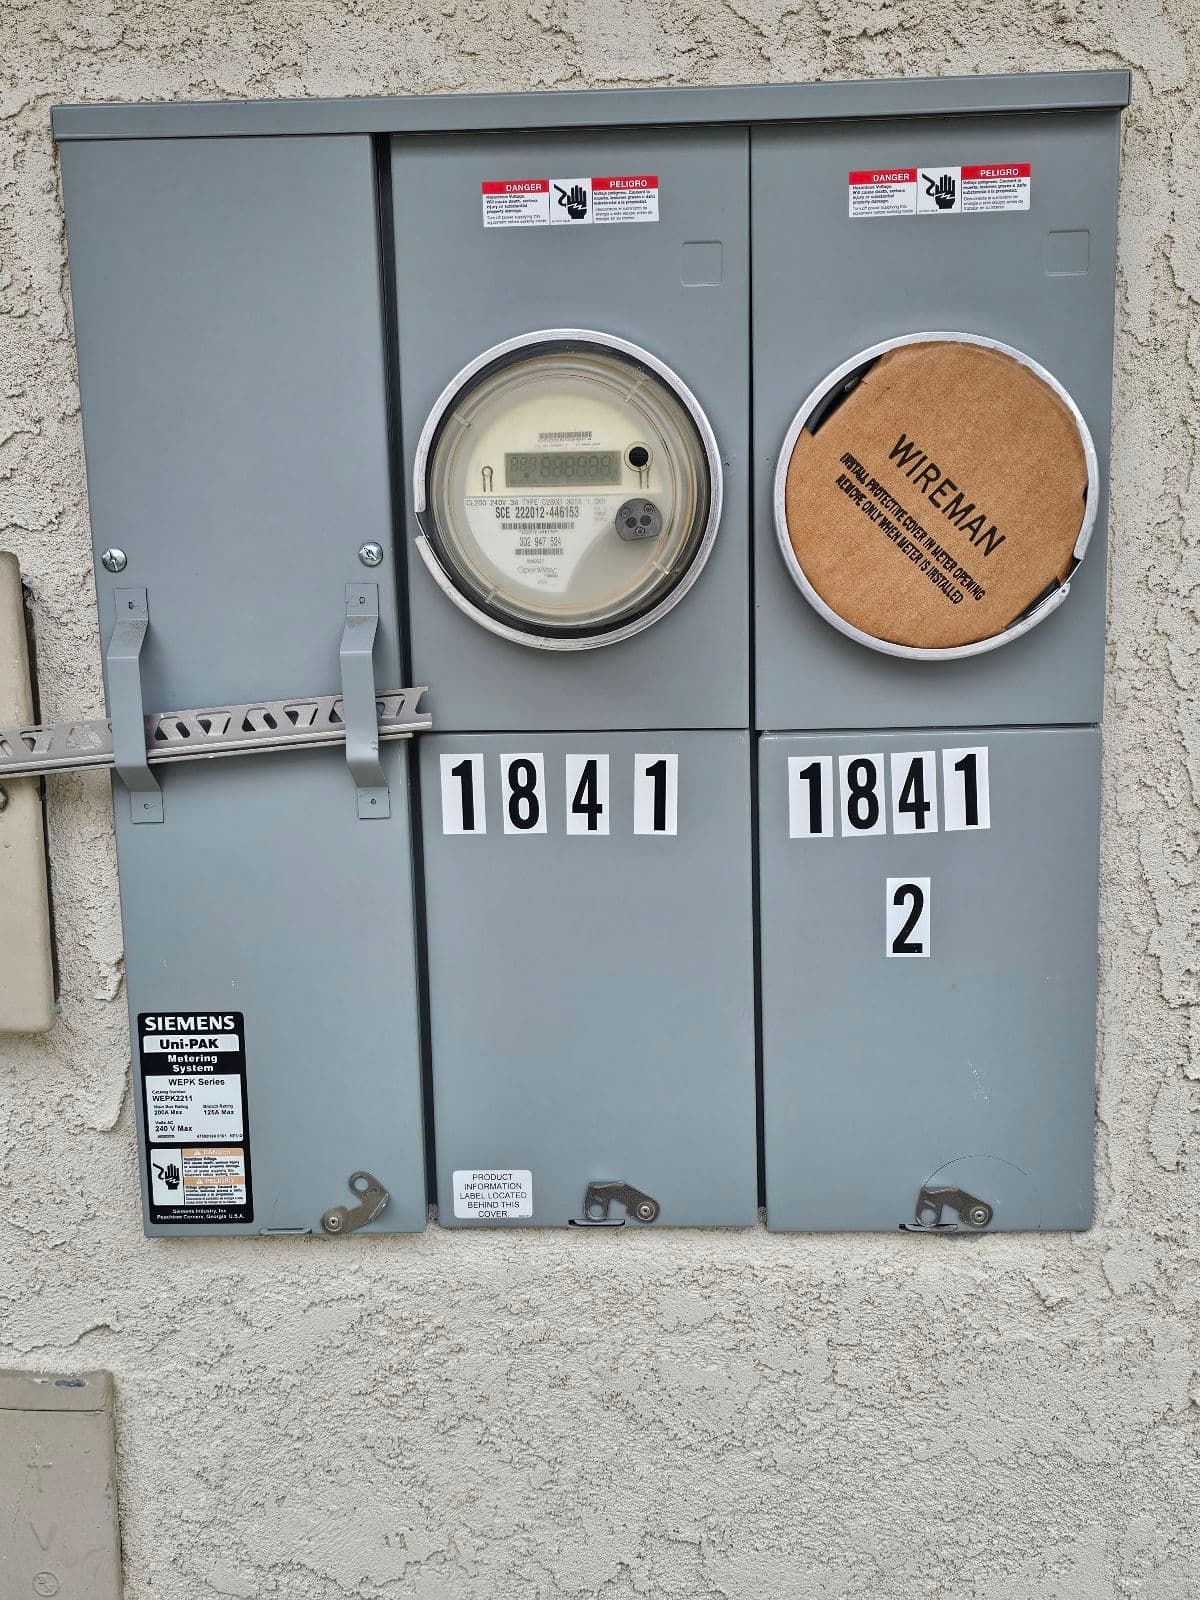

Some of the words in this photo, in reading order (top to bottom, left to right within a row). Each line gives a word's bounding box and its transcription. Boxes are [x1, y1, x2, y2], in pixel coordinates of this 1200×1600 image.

[980, 168, 1019, 176] PELIGRO
[873, 174, 910, 182] DANGER
[505, 184, 542, 192] DANGER
[609, 180, 648, 188] PELIGRO
[888, 434, 1006, 556] WIREMAN
[495, 507, 510, 518] SCE
[515, 506, 579, 518] 222012-446153
[840, 452, 869, 484] INSTALL
[865, 478, 908, 522] PROTECTIVE
[902, 516, 928, 542] COVER
[923, 537, 937, 551] IN
[931, 545, 958, 572] METER
[952, 568, 986, 601] OPENING
[519, 537, 531, 546] 302
[534, 537, 546, 546] 947
[835, 473, 868, 506] REMOVE
[862, 500, 884, 522] ONLY
[878, 516, 903, 542] WHEN
[897, 537, 924, 564] METER
[919, 559, 931, 571] IS
[926, 566, 963, 604] INSTALLED
[800, 753, 979, 834] 1841
[892, 883, 925, 954] 2
[144, 1016, 235, 1031] SIEMENS
[160, 1039, 219, 1050] Uni-PAK
[168, 1054, 218, 1064] Metering
[172, 1064, 214, 1073] System
[168, 1078, 195, 1086] WEPK
[198, 1078, 225, 1086] Series
[460, 1192, 486, 1200] LABEL
